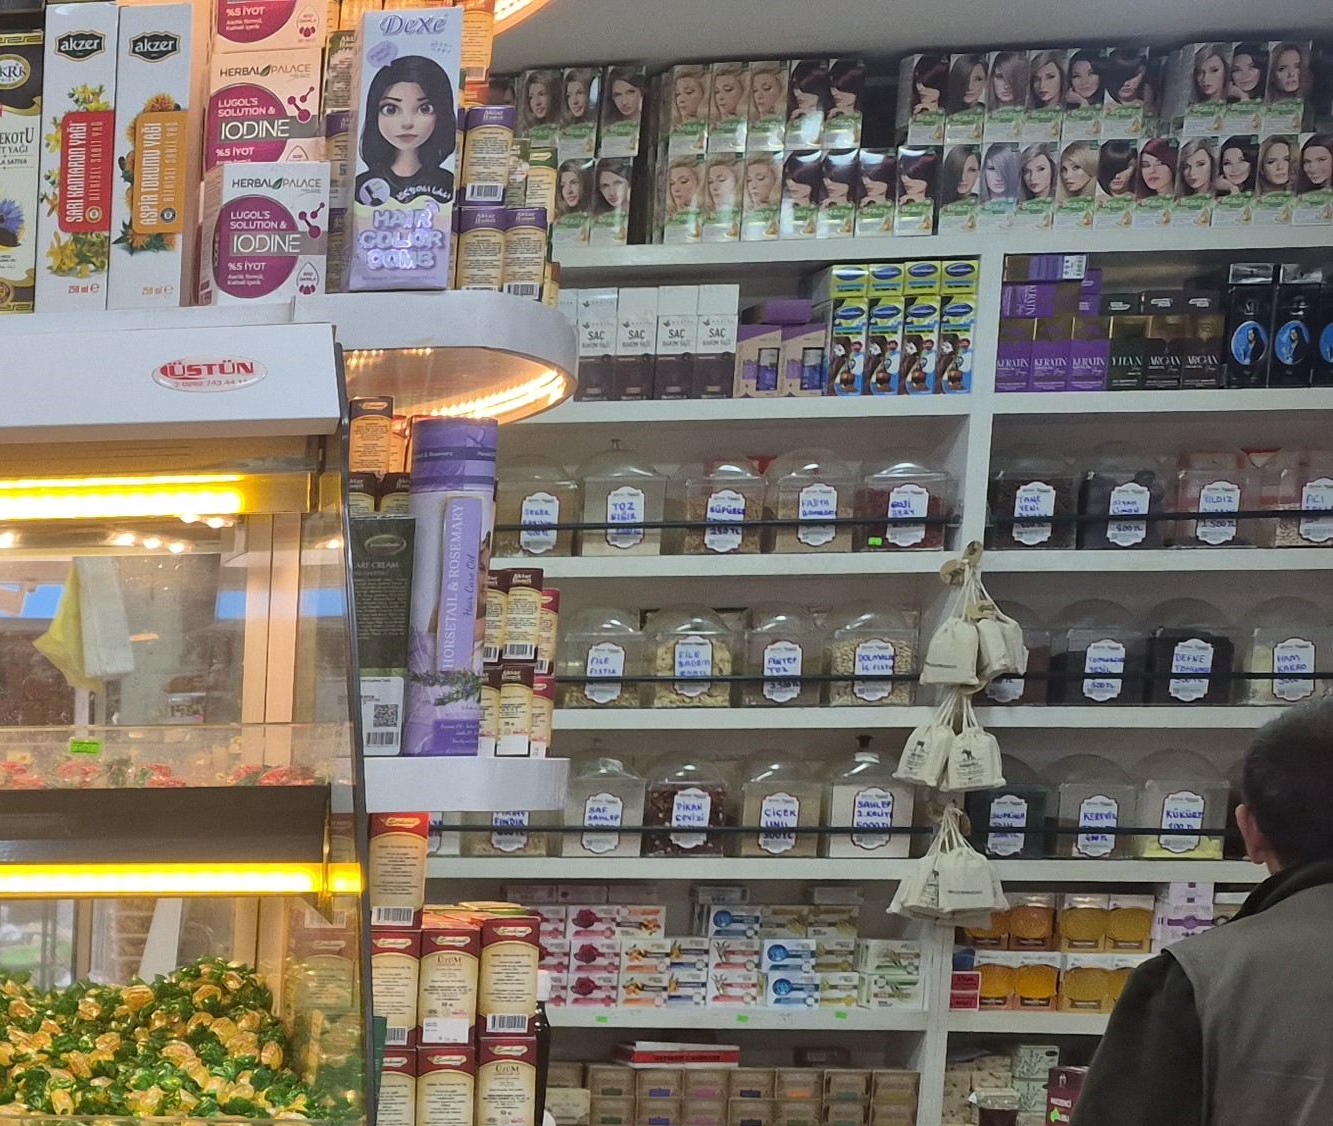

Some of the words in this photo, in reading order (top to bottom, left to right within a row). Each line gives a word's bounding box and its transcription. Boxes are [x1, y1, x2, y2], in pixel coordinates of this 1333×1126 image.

[242, 5, 266, 16] İYOT
[60, 37, 100, 50] akzer
[134, 38, 174, 52] akzer
[220, 66, 260, 77] HERBAL
[271, 64, 311, 74] PALACE
[218, 97, 259, 107] LUGOL'S
[218, 107, 266, 117] SOLUTION
[267, 106, 276, 115] &
[68, 121, 87, 146] YAĞI
[144, 122, 162, 147] YAĞI
[221, 119, 290, 140] IODINE
[8, 145, 29, 154] YAĞI
[232, 146, 255, 156] İYOT
[67, 146, 86, 198] KANTARON
[141, 148, 161, 192] TOHUMU
[232, 178, 272, 189] HERBAL
[283, 178, 321, 188] PALACE
[66, 198, 84, 223] SARI
[139, 194, 158, 225] ASPİR
[230, 210, 270, 220] LUGOL'S
[229, 220, 277, 230] SOLUTION
[279, 220, 287, 229] &
[373, 208, 433, 229] HAIR
[233, 233, 301, 253] IODINE
[360, 229, 445, 250] COLOR
[244, 260, 267, 271] İYOT
[367, 249, 437, 270] COMB
[68, 284, 80, 294] 250
[588, 330, 605, 341] SAÇ
[628, 329, 646, 341] SAÇ
[668, 329, 686, 340] SAÇ
[708, 327, 726, 339] SAÇ
[167, 359, 255, 377] ÜSTÜN
[449, 504, 464, 578] ROSEMARY
[371, 560, 399, 569] CREAM
[443, 593, 458, 670] HORSETAIL
